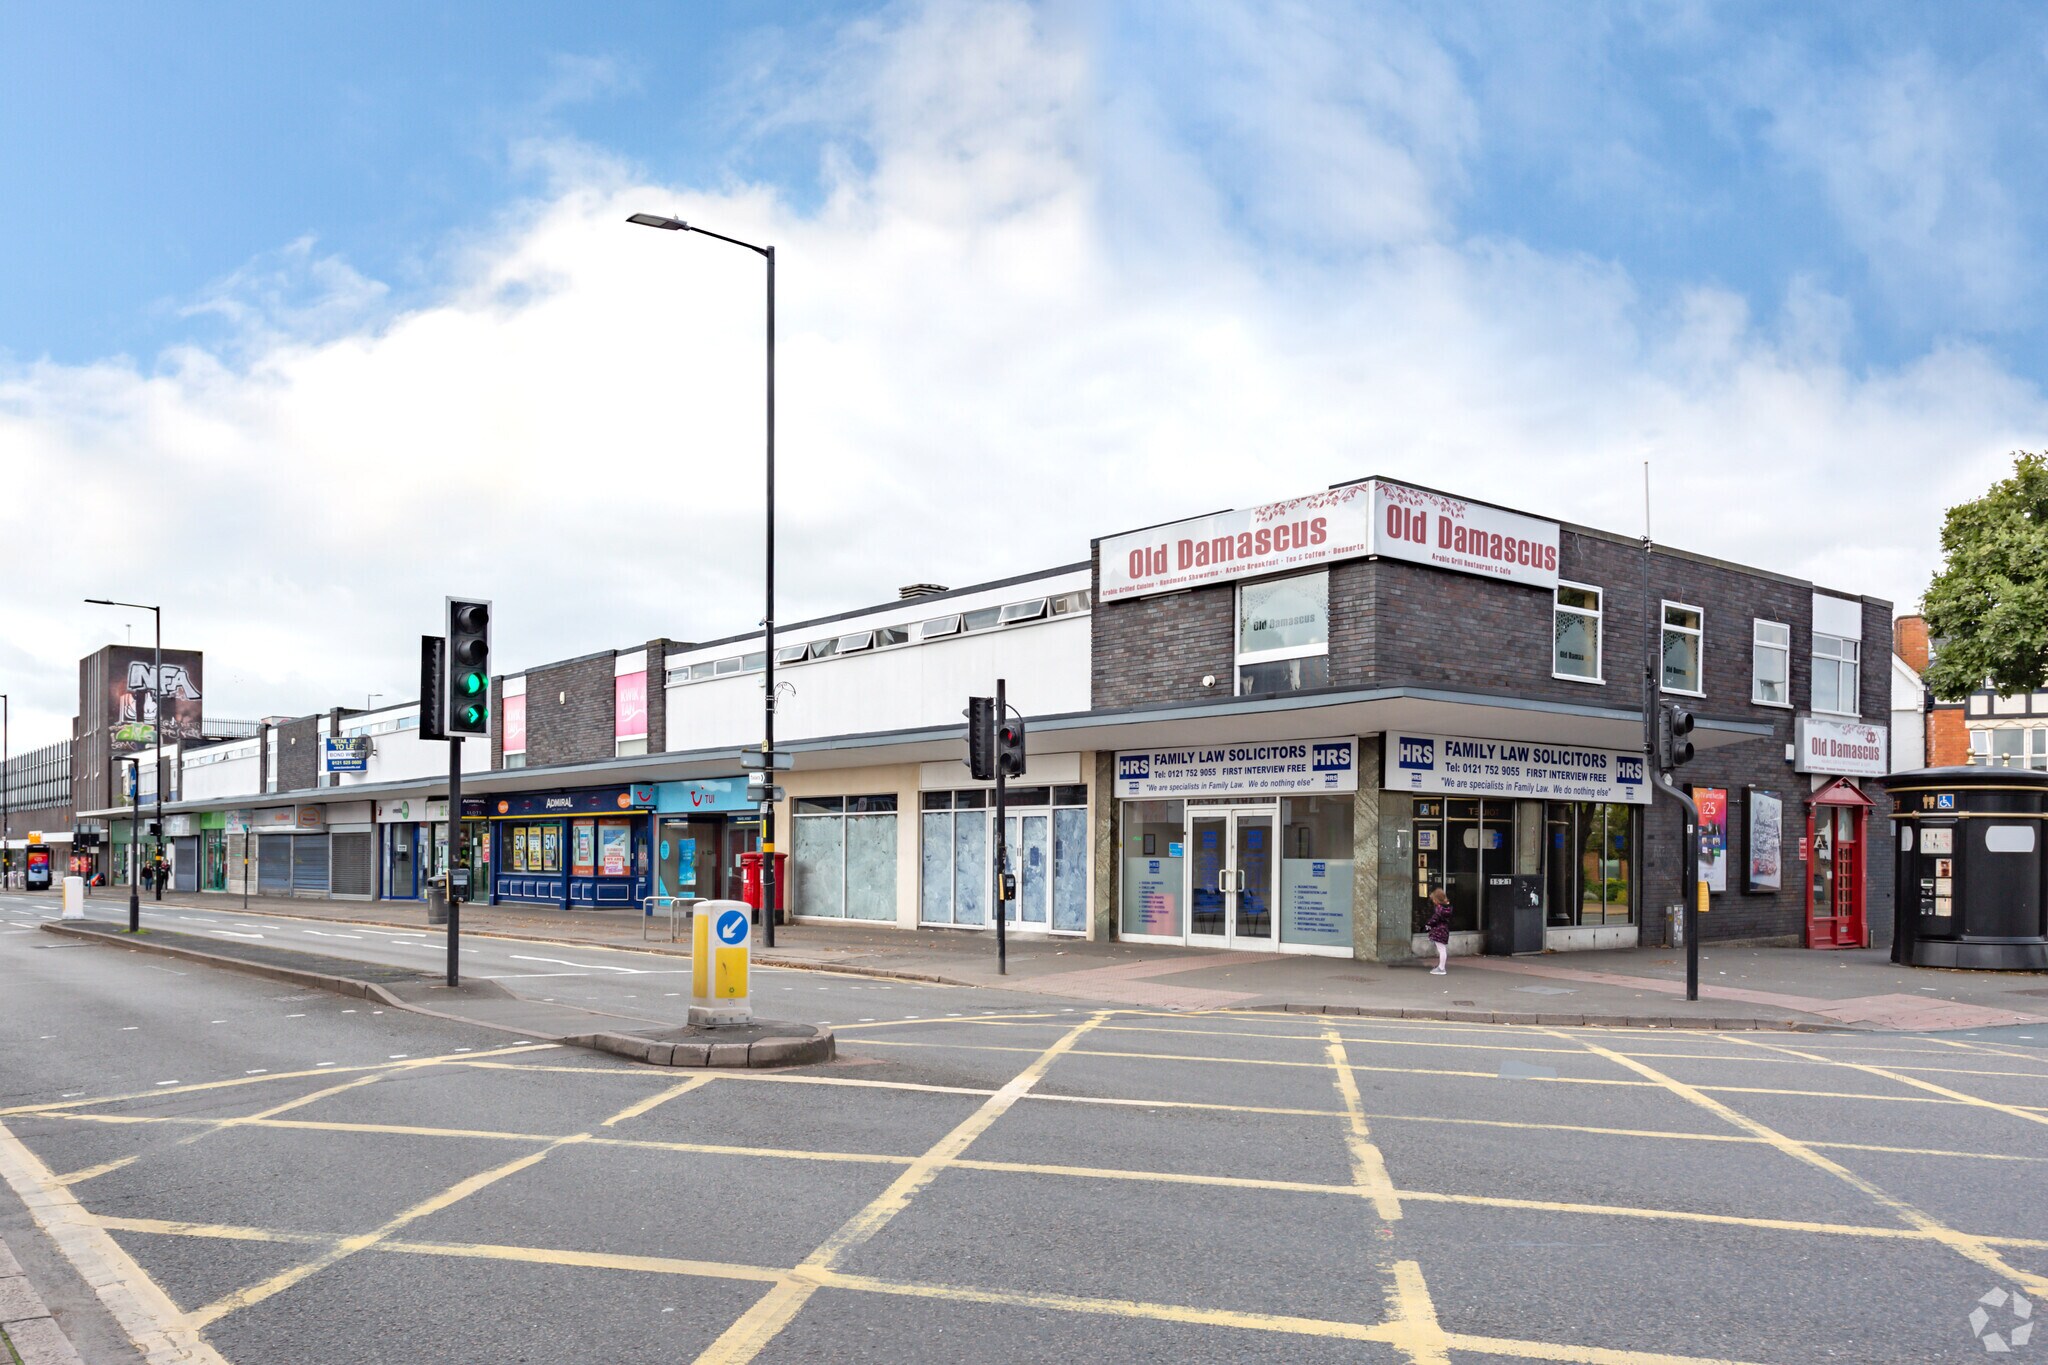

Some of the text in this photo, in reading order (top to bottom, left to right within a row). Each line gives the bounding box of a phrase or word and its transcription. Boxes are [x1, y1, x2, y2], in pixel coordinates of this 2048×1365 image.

[1386, 504, 1556, 571] Old Damascus
[1129, 517, 1327, 579] Old Damascus
[1120, 585, 1135, 593] Grilled
[1160, 577, 1187, 586] Handmade
[1188, 570, 1218, 580] Shawarma
[1225, 565, 1246, 574] Arabic
[1247, 559, 1279, 570] Breakfast
[1304, 551, 1326, 559] Coffee
[1333, 544, 1364, 554] Desserts
[1432, 553, 1450, 563] Arabic
[1451, 557, 1463, 566] Grill
[1464, 560, 1493, 572] Restaurant
[1500, 567, 1511, 575] Cafe
[1254, 614, 1315, 631] Old Damascus
[1812, 737, 1880, 761] Old Damascus
[1120, 745, 1351, 775] HRS FAMILY LAW SOLICITORS HRS
[1399, 740, 1643, 779] HRS FAMILY LAW SOLICITORS HRS
[1168, 769, 1183, 778] 0121
[1186, 769, 1198, 777] 752
[1200, 768, 1216, 776] 9055
[1222, 767, 1242, 775] FIRST
[1244, 765, 1285, 774] INTERVIEW
[1287, 764, 1306, 772] FREE
[1446, 762, 1607, 782] Tel: 0121 752 9055 FIRST INTERVIEW FREE
[1169, 783, 1199, 792] specialists
[1201, 782, 1207, 790] in
[1208, 781, 1228, 790] Family
[1230, 780, 1244, 789] Law.
[1248, 780, 1258, 788] We
[1260, 779, 1269, 787] do
[1270, 778, 1295, 788] nothing
[1457, 780, 1467, 788] are
[1469, 779, 1503, 790] specialists
[1506, 781, 1512, 790] in
[1514, 781, 1534, 794] Family
[1536, 783, 1549, 793] Law.
[1553, 784, 1562, 794] We
[1564, 785, 1572, 794] do
[1573, 786, 1595, 797] nothing
[546, 797, 573, 808] ADMIRAL
[705, 794, 715, 804] TUI
[515, 835, 524, 850] 50
[545, 834, 555, 850] 50
